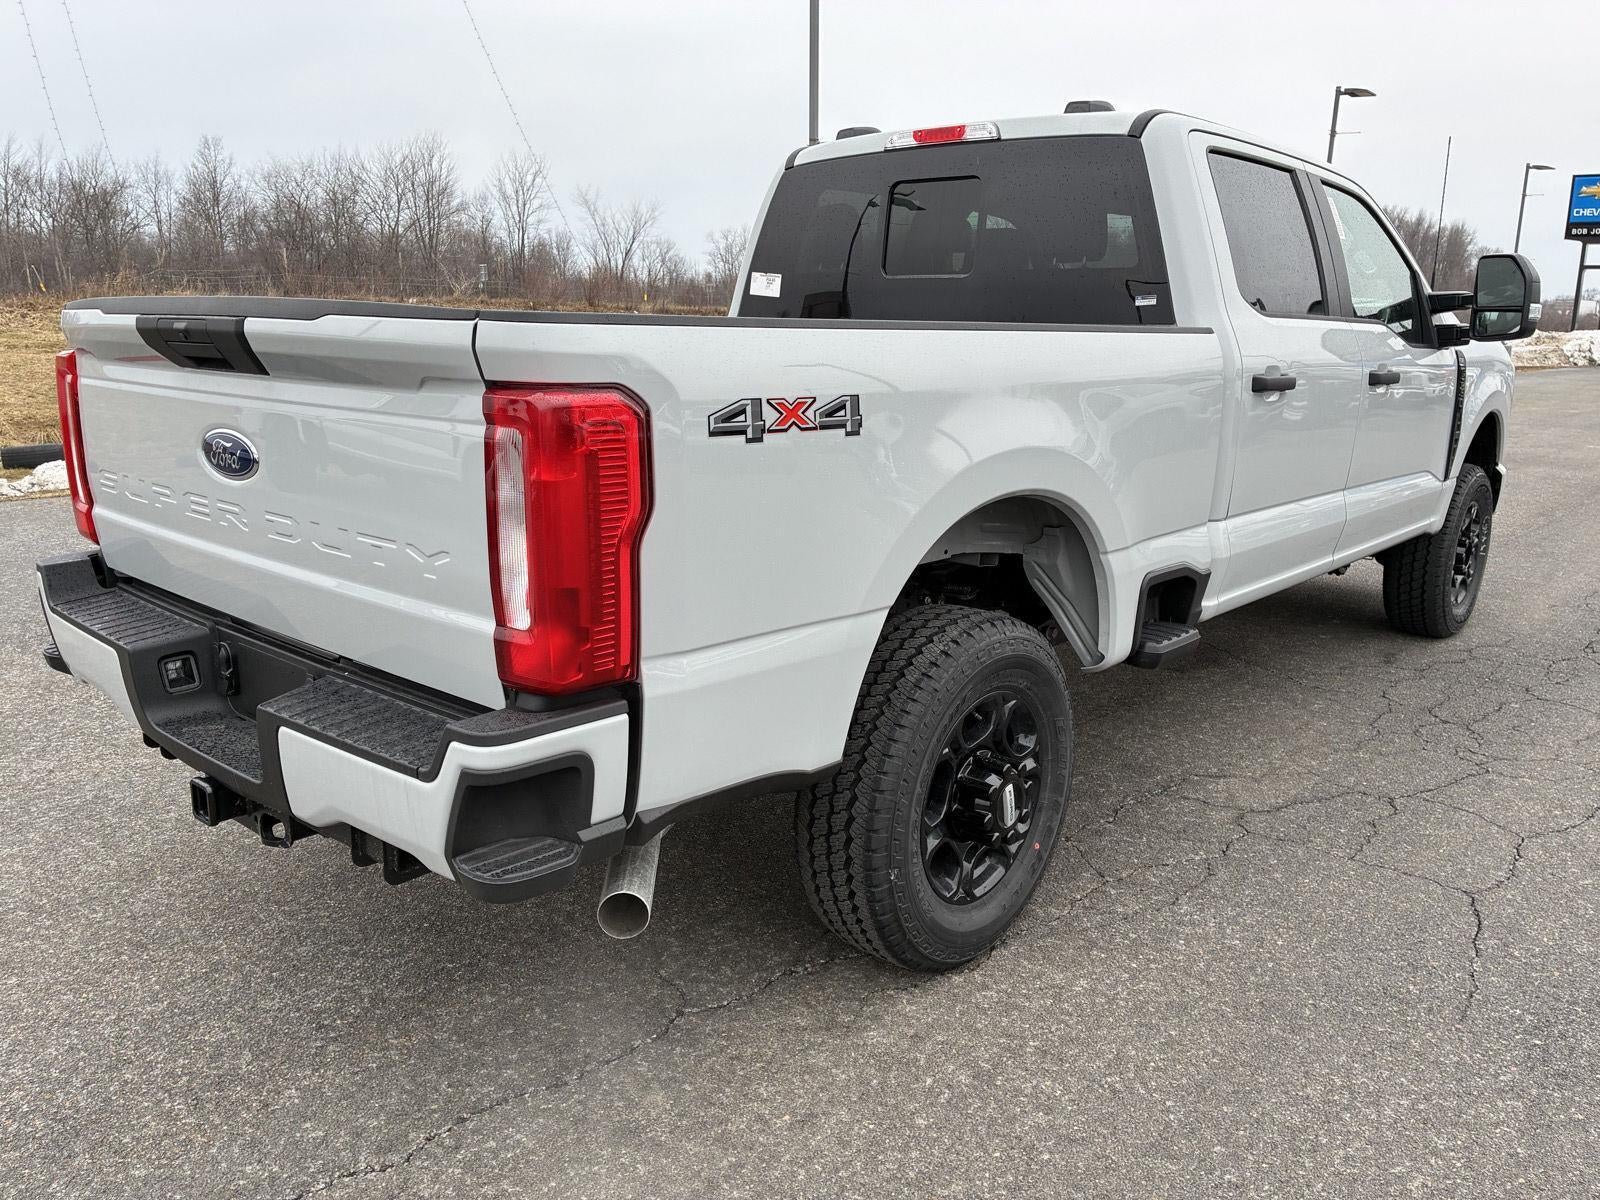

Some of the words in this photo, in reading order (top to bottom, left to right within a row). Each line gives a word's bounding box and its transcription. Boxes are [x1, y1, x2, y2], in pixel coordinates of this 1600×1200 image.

[1572, 228, 1588, 236] BOB
[210, 438, 241, 469] Ford
[99, 468, 249, 532] SUPER
[264, 510, 451, 579] DUTY
